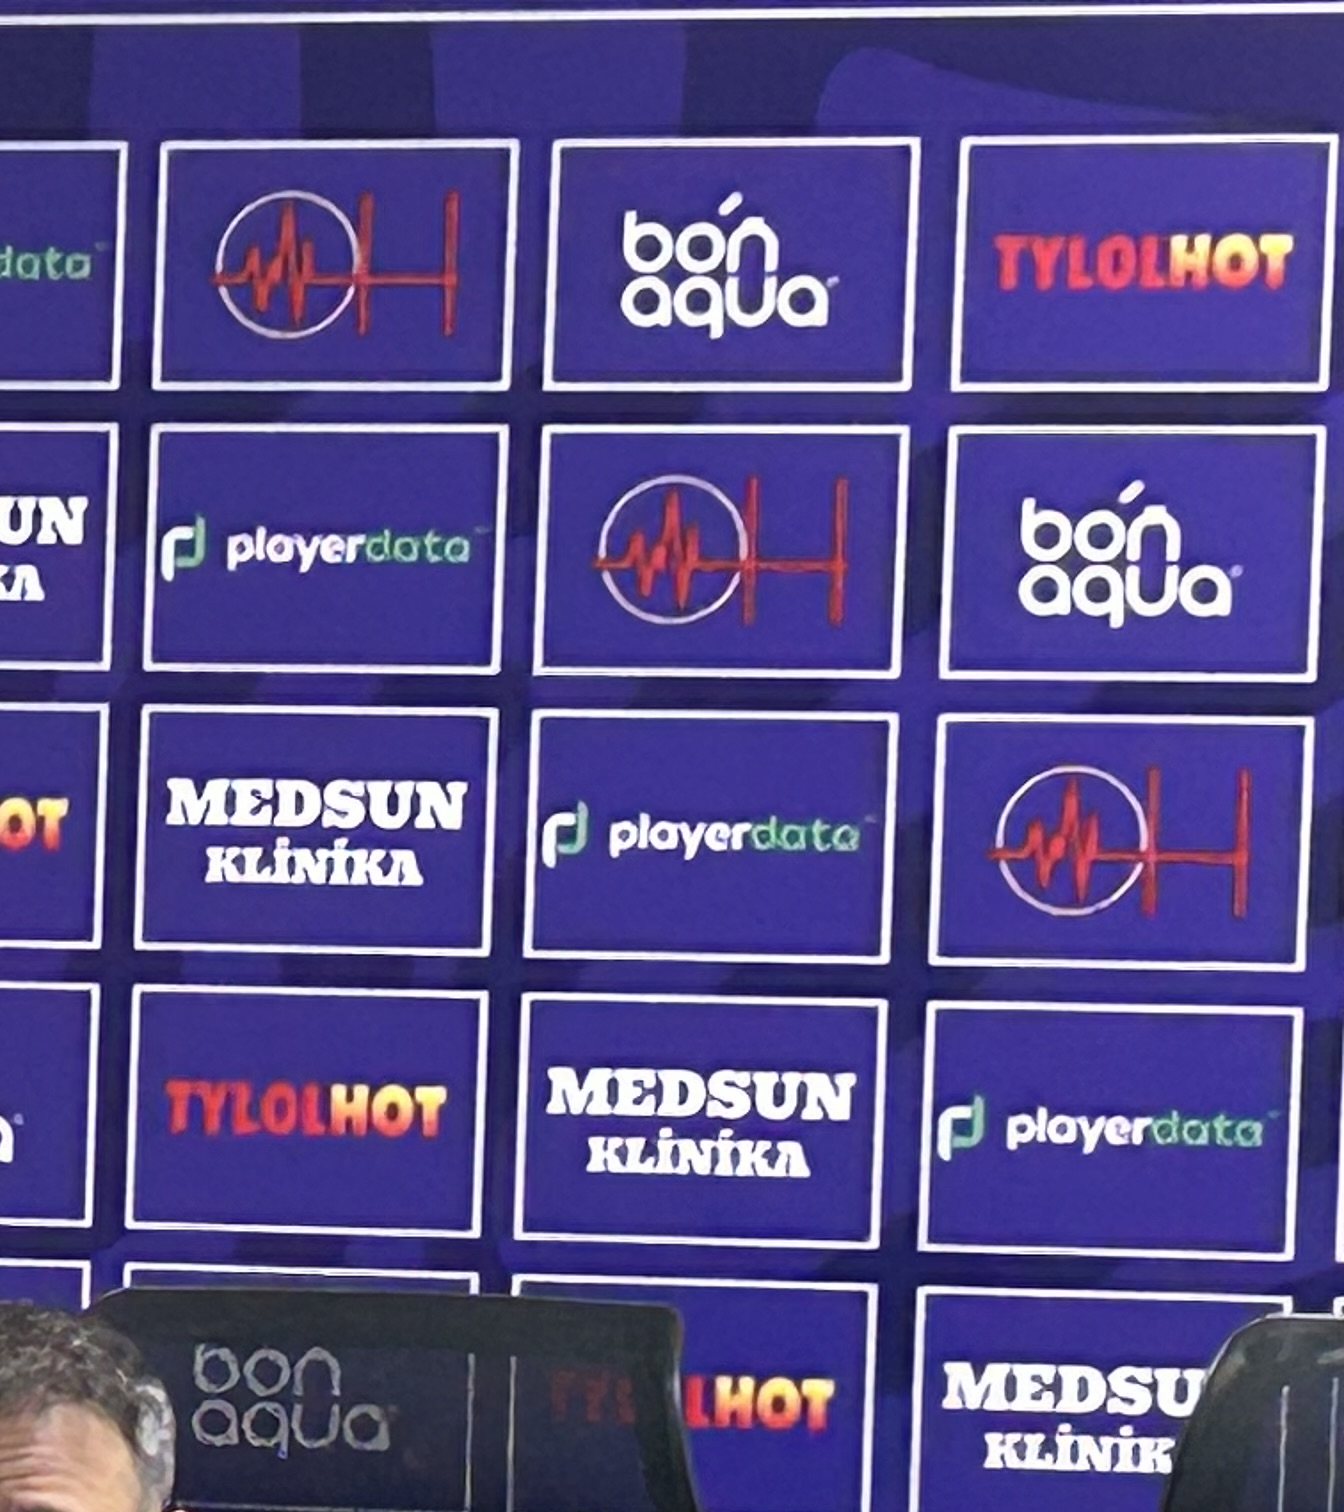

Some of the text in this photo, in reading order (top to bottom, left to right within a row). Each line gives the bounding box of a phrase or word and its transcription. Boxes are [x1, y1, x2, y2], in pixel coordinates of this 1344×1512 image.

[620, 274, 829, 340] aqua
[227, 526, 470, 573] playerdata
[1018, 564, 1231, 629] aqua
[165, 777, 468, 830] MEDSUN
[609, 812, 860, 860] playerdata
[546, 1066, 857, 1121] MEDSUN
[1006, 1106, 1264, 1155] playerdata
[942, 1361, 1206, 1417] MEDSU
[983, 1423, 1176, 1474] KLİNİK
